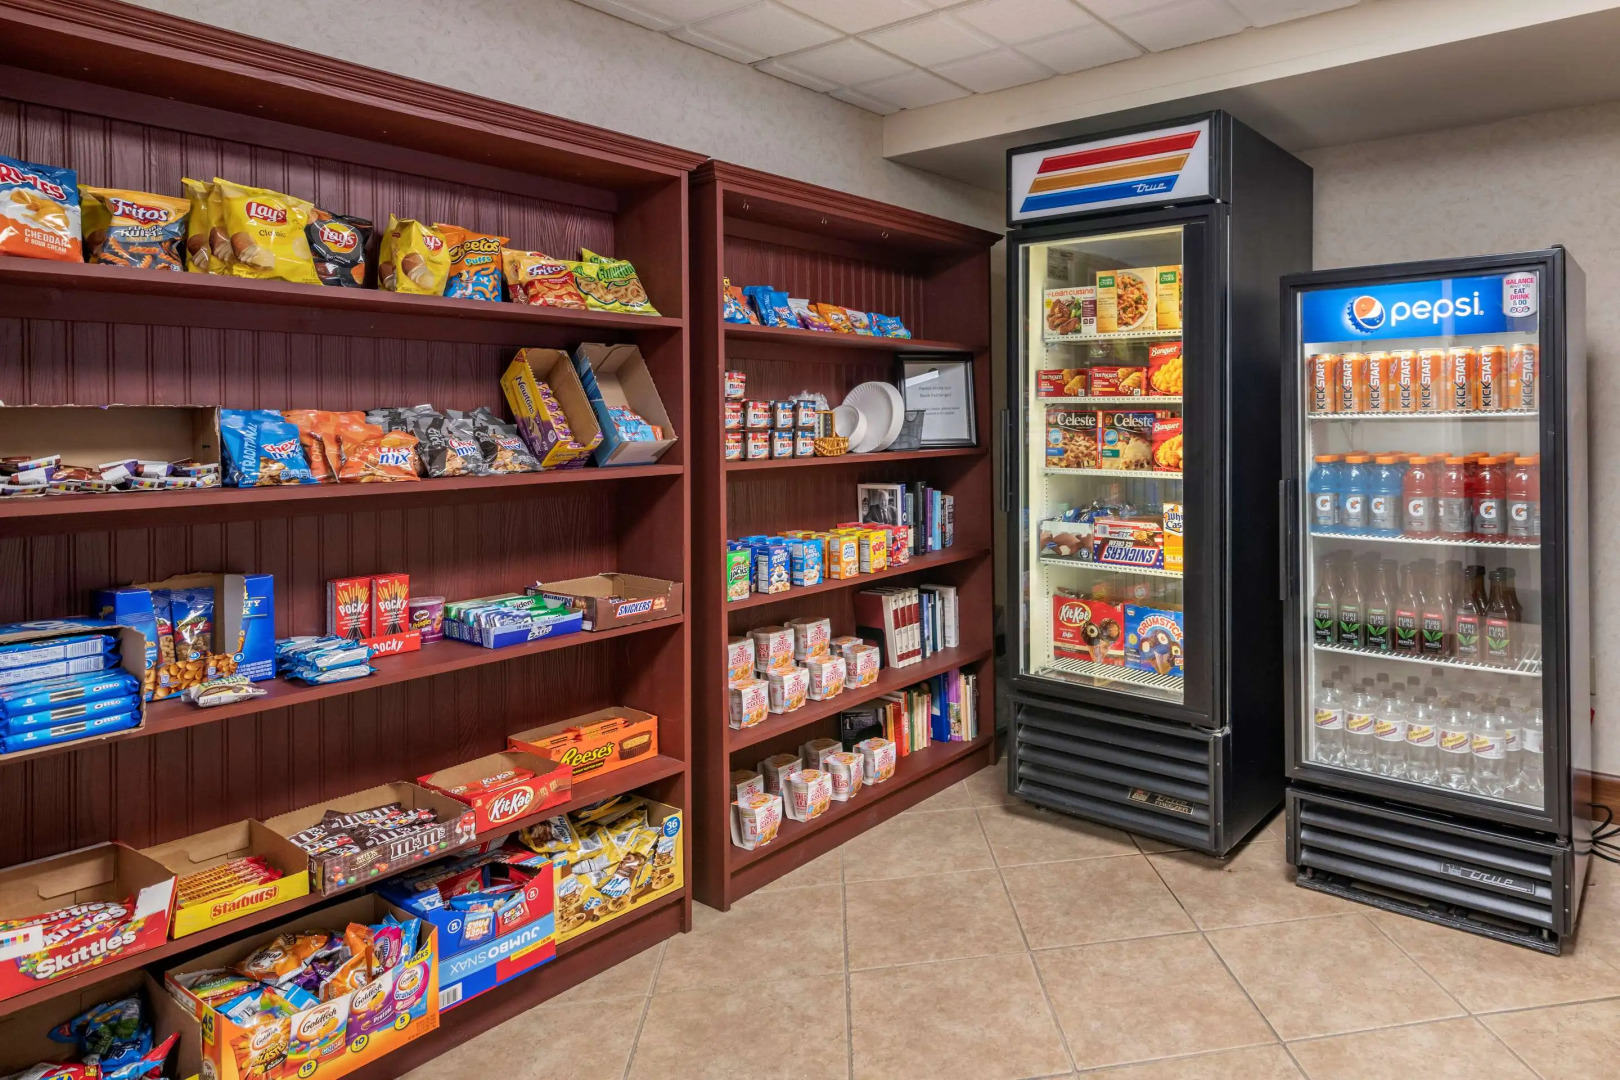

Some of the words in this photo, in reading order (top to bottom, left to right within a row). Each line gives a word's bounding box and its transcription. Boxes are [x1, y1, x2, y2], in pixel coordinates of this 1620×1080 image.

[0, 163, 67, 200] RULES
[1132, 182, 1167, 193] true
[110, 198, 169, 222] Fritos
[250, 202, 286, 223] Lay's
[24, 228, 69, 246] CHEDDAR
[30, 239, 46, 248] SOUR
[47, 242, 67, 253] CREAM
[465, 255, 493, 266] Puffs
[527, 263, 568, 277] Fritos
[1391, 291, 1480, 326] pepsi
[515, 376, 535, 415] Newtons
[1057, 412, 1096, 426] Celeste
[1114, 413, 1154, 427] Celeste
[1154, 422, 1180, 432] Banquet
[262, 438, 298, 453] Chex
[1316, 495, 1331, 511] G
[1346, 496, 1361, 513] G
[1371, 497, 1385, 514] G
[1408, 499, 1424, 516] G
[1480, 501, 1496, 519] G
[1511, 503, 1527, 521] G
[1103, 546, 1156, 563] SNICKERS
[618, 600, 652, 615] SNICKERS
[1060, 604, 1089, 624] KitKat
[1137, 616, 1183, 641] DRUMSTICK
[92, 682, 120, 692] OREO
[561, 742, 615, 767] Reese's
[489, 791, 531, 822] KitKat
[211, 886, 279, 920] Starburst
[36, 931, 136, 979] Skittles
[354, 982, 383, 1008] Goldfish
[202, 1013, 214, 1033] 45
[302, 1008, 337, 1033] Goldfish
[373, 1006, 392, 1023] Pretzel
[400, 1015, 405, 1023] 5
[355, 1037, 365, 1046] 10
[302, 1063, 313, 1072] 15
